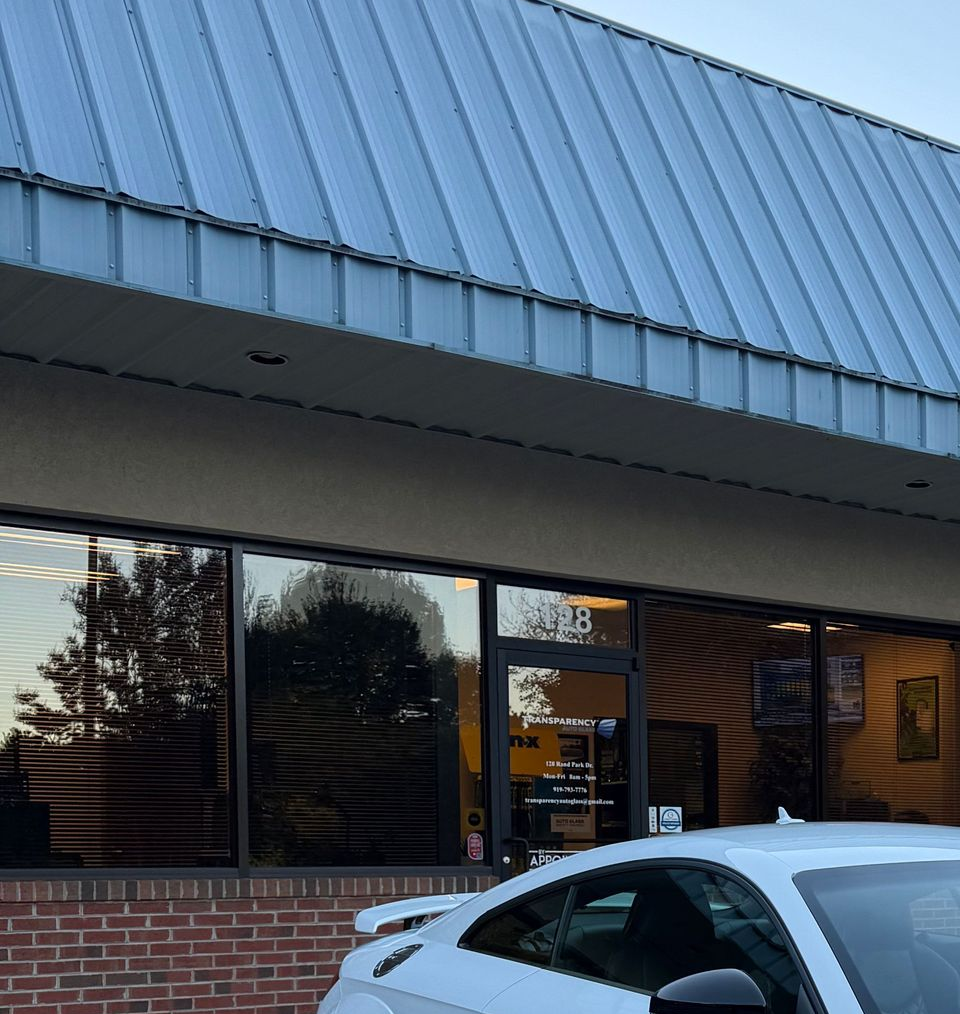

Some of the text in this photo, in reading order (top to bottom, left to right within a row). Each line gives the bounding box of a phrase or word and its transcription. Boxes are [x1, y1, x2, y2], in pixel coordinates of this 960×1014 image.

[540, 602, 592, 633] 128
[522, 716, 596, 727] TRANSPARENCY
[530, 854, 568, 866] APPO
